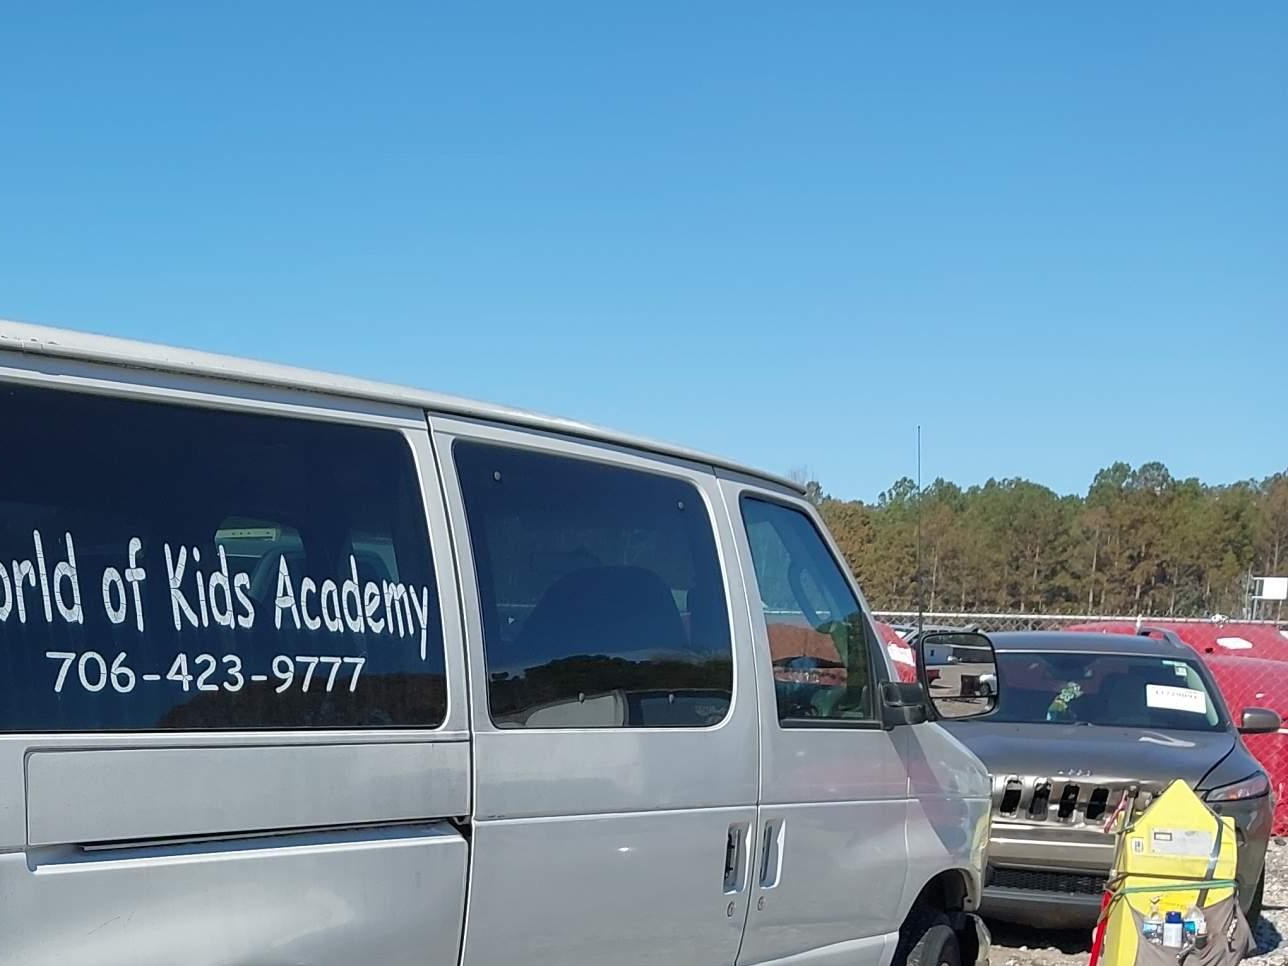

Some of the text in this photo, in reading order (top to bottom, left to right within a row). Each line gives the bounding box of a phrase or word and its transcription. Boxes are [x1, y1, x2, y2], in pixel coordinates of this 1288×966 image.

[103, 536, 144, 632] of
[164, 542, 256, 632] Kids
[274, 553, 429, 661] Academy
[45, 650, 367, 694] 706-423-9777
